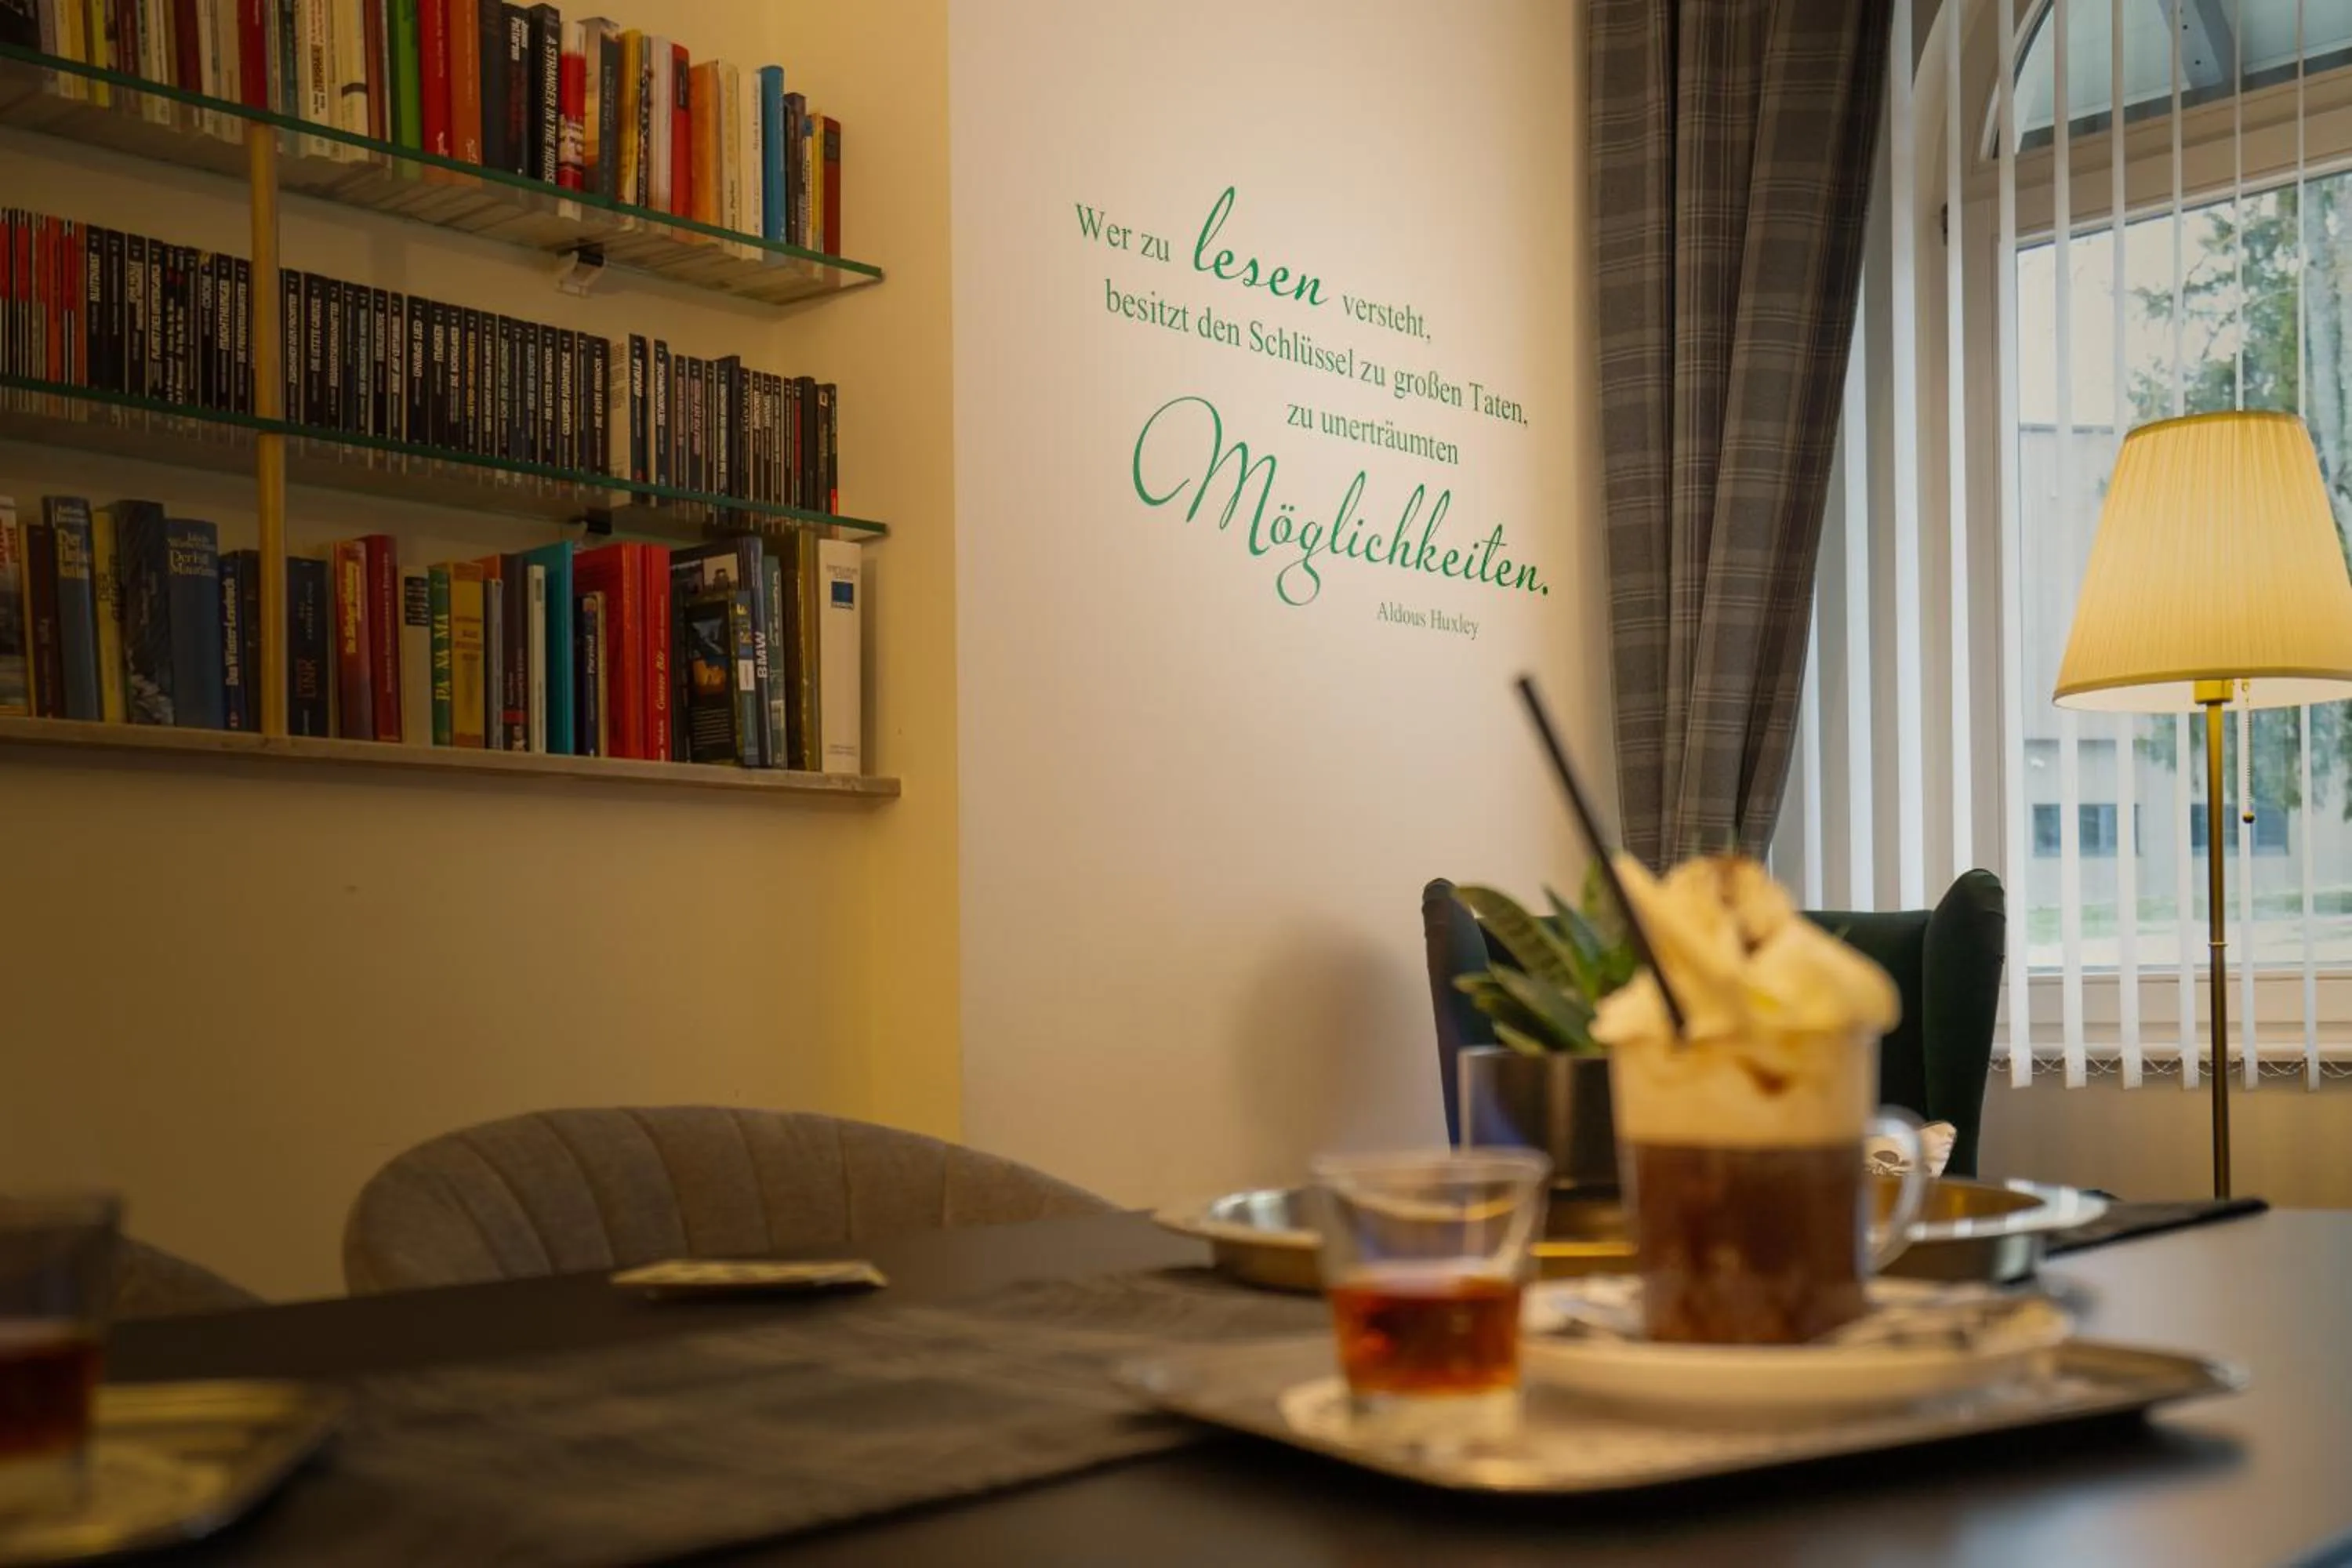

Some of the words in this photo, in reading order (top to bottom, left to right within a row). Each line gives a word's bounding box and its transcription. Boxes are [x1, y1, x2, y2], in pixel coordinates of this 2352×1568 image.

[510, 16, 521, 61] Patterson
[545, 45, 556, 107] STRANGER
[545, 108, 556, 119] IN
[545, 123, 556, 143] THE
[544, 146, 556, 185] HOUSE
[1076, 202, 1132, 249] Wer
[1141, 234, 1171, 263] zu
[1192, 186, 1328, 307] lesen
[1105, 277, 1189, 332] besitzt
[1196, 308, 1240, 348] den
[1249, 321, 1353, 378] Schlüssel
[1360, 361, 1385, 390] zu
[1394, 371, 1461, 407] großen
[1287, 403, 1313, 430] zu
[1320, 411, 1459, 467] unerträumten
[1133, 395, 1549, 607] Möglichkeiten.
[433, 614, 449, 639] MA
[1377, 602, 1425, 626] Aldous
[1432, 610, 1477, 640] Huxley
[755, 630, 768, 678] BMW
